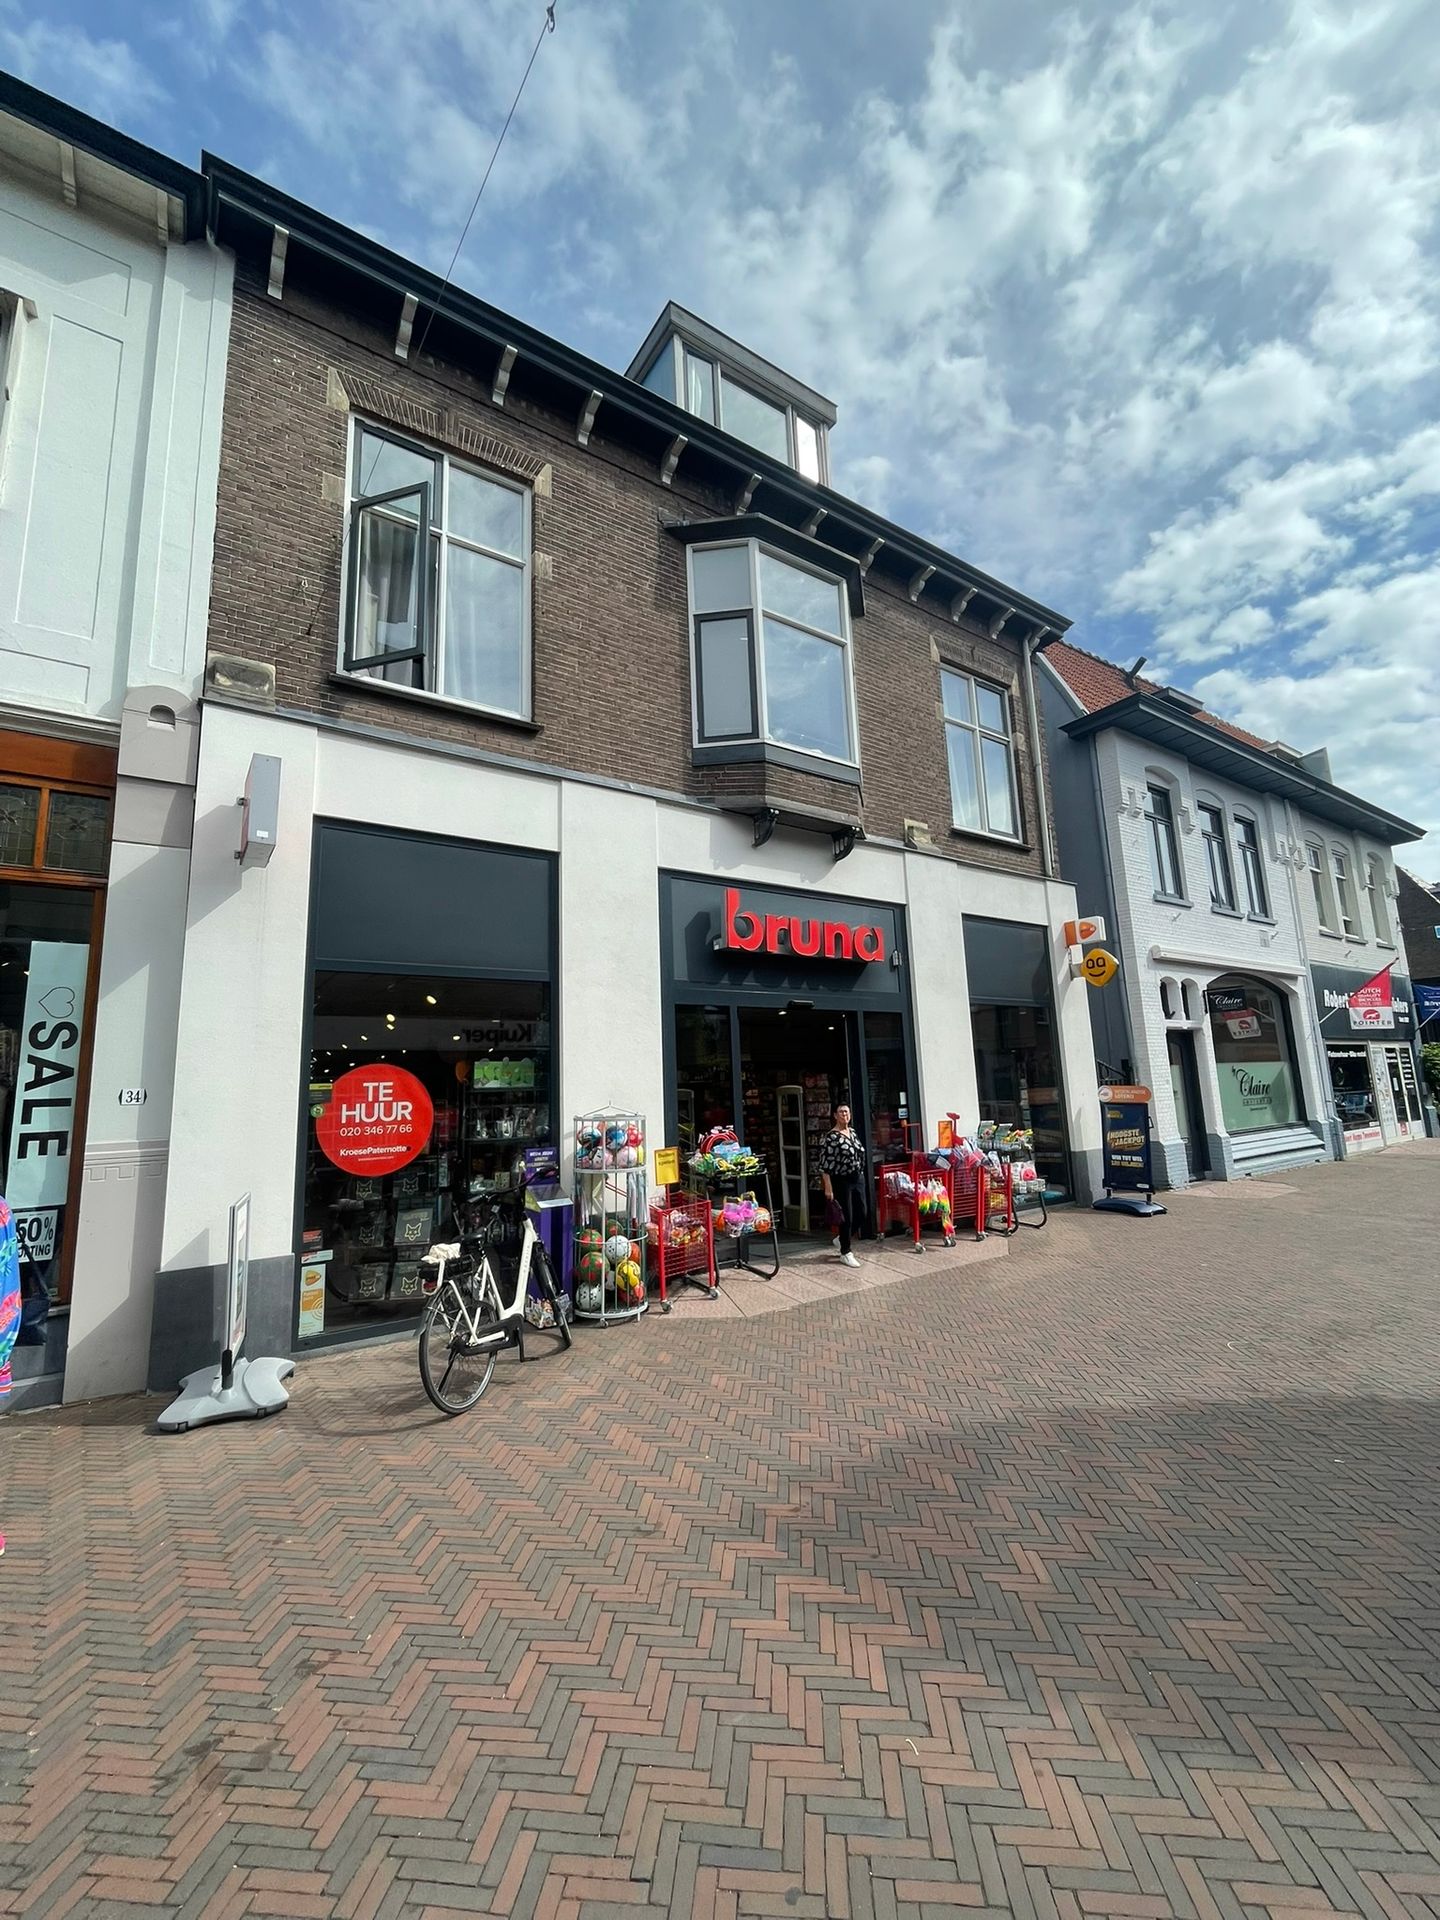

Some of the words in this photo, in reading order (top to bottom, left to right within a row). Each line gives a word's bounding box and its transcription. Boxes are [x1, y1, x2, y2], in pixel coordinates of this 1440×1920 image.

[725, 888, 885, 961] bruna
[1323, 989, 1349, 1009] Robert
[17, 1021, 79, 1159] SALE
[363, 1082, 394, 1102] TE
[1236, 1068, 1271, 1097] Claire
[126, 1090, 142, 1103] 34
[341, 1102, 413, 1124] HUUR
[340, 1127, 361, 1137] 020
[364, 1125, 383, 1136] 346
[386, 1124, 397, 1134] 77
[399, 1124, 413, 1133] 66
[16, 1216, 54, 1243] 50%
